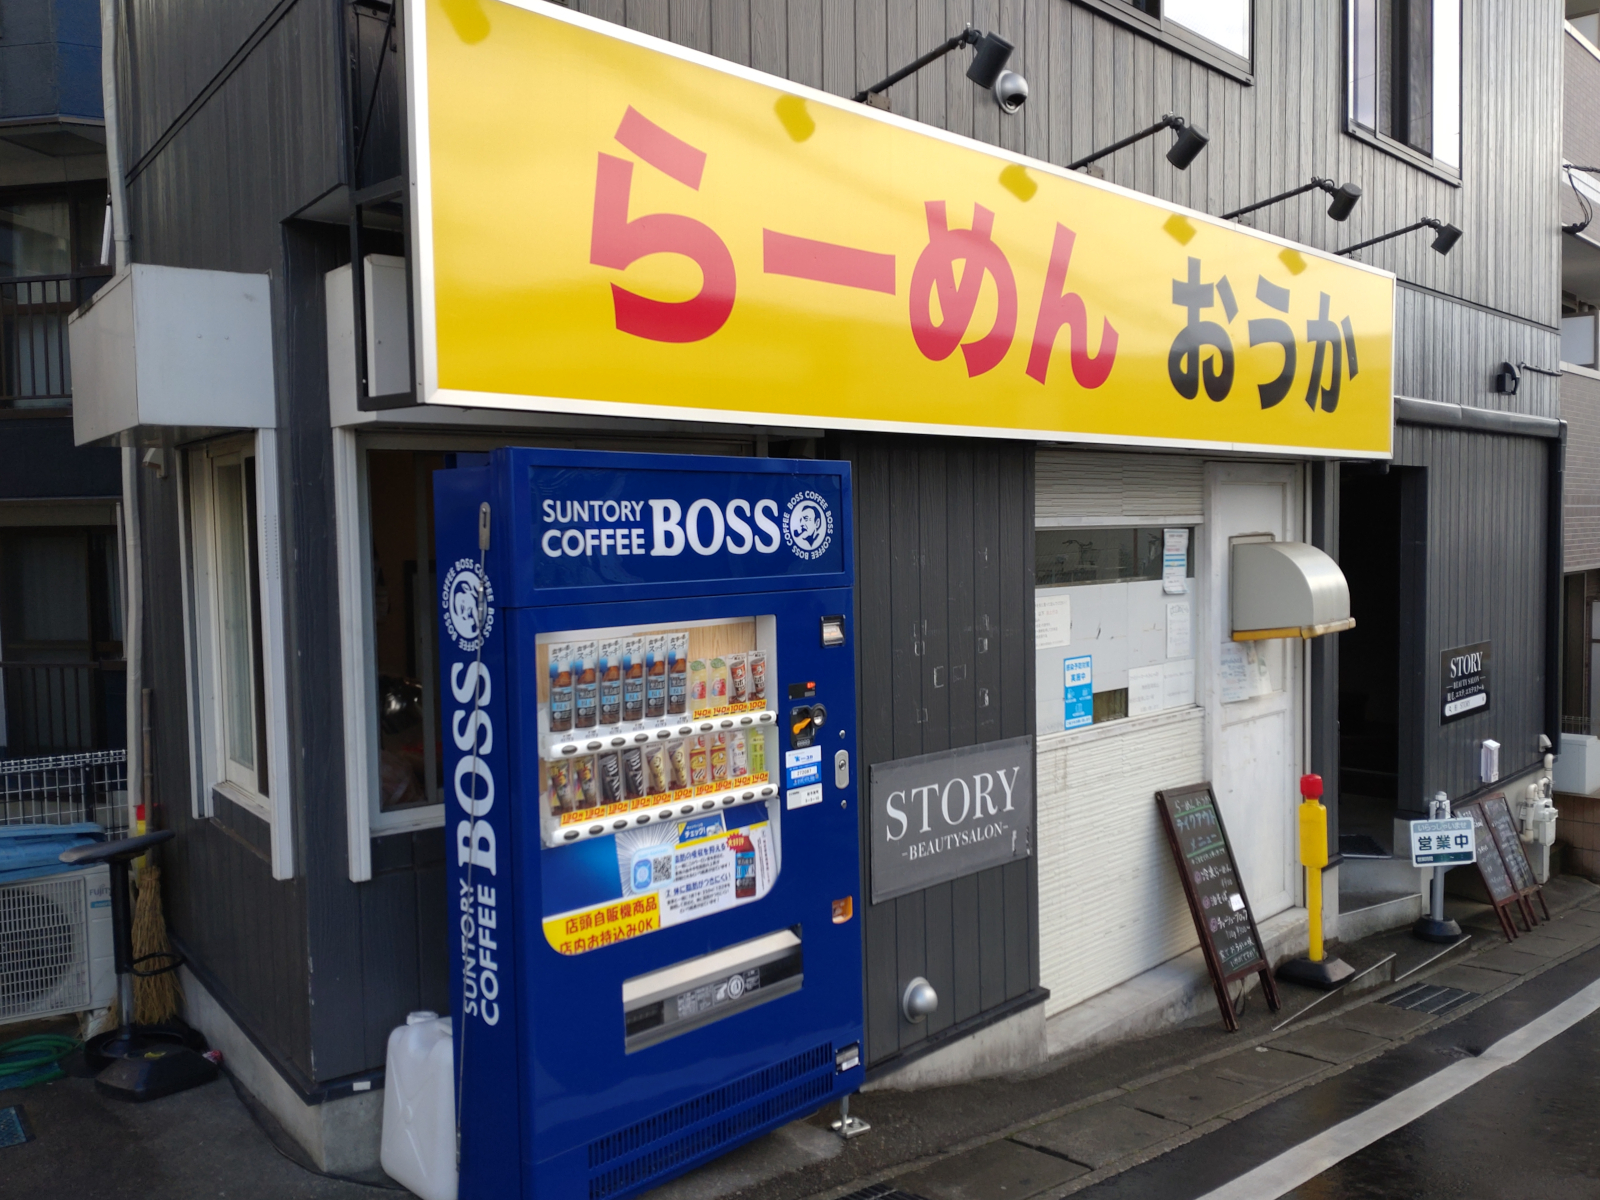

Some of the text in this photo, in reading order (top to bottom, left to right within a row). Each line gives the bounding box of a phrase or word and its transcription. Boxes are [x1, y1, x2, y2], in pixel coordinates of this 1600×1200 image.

[590, 104, 1359, 413] らーめん おうか
[542, 499, 644, 523] SUNTORY
[782, 490, 834, 560] BOSS COFFEE BOSS COFFEE BOSS COFFEE
[648, 498, 781, 556] BOSS
[542, 528, 646, 557] COFFEE
[455, 558, 474, 572] BOSS
[442, 567, 456, 609] COFFEE
[443, 612, 458, 641] BOSS
[482, 607, 495, 638] BOSS
[458, 636, 485, 652] COFFEE
[1450, 651, 1484, 679] STORY
[450, 660, 497, 877] BOSS
[886, 766, 1020, 842] STORY
[1176, 808, 1216, 834] テイクアウト
[1417, 821, 1468, 832] いらっしゃいませ
[1190, 833, 1217, 852] メニュー
[1417, 834, 1469, 851] 営業中
[565, 896, 657, 936] 店頭自販機商品
[459, 877, 478, 1017] SUNTORY
[477, 884, 500, 1027] COFFEE
